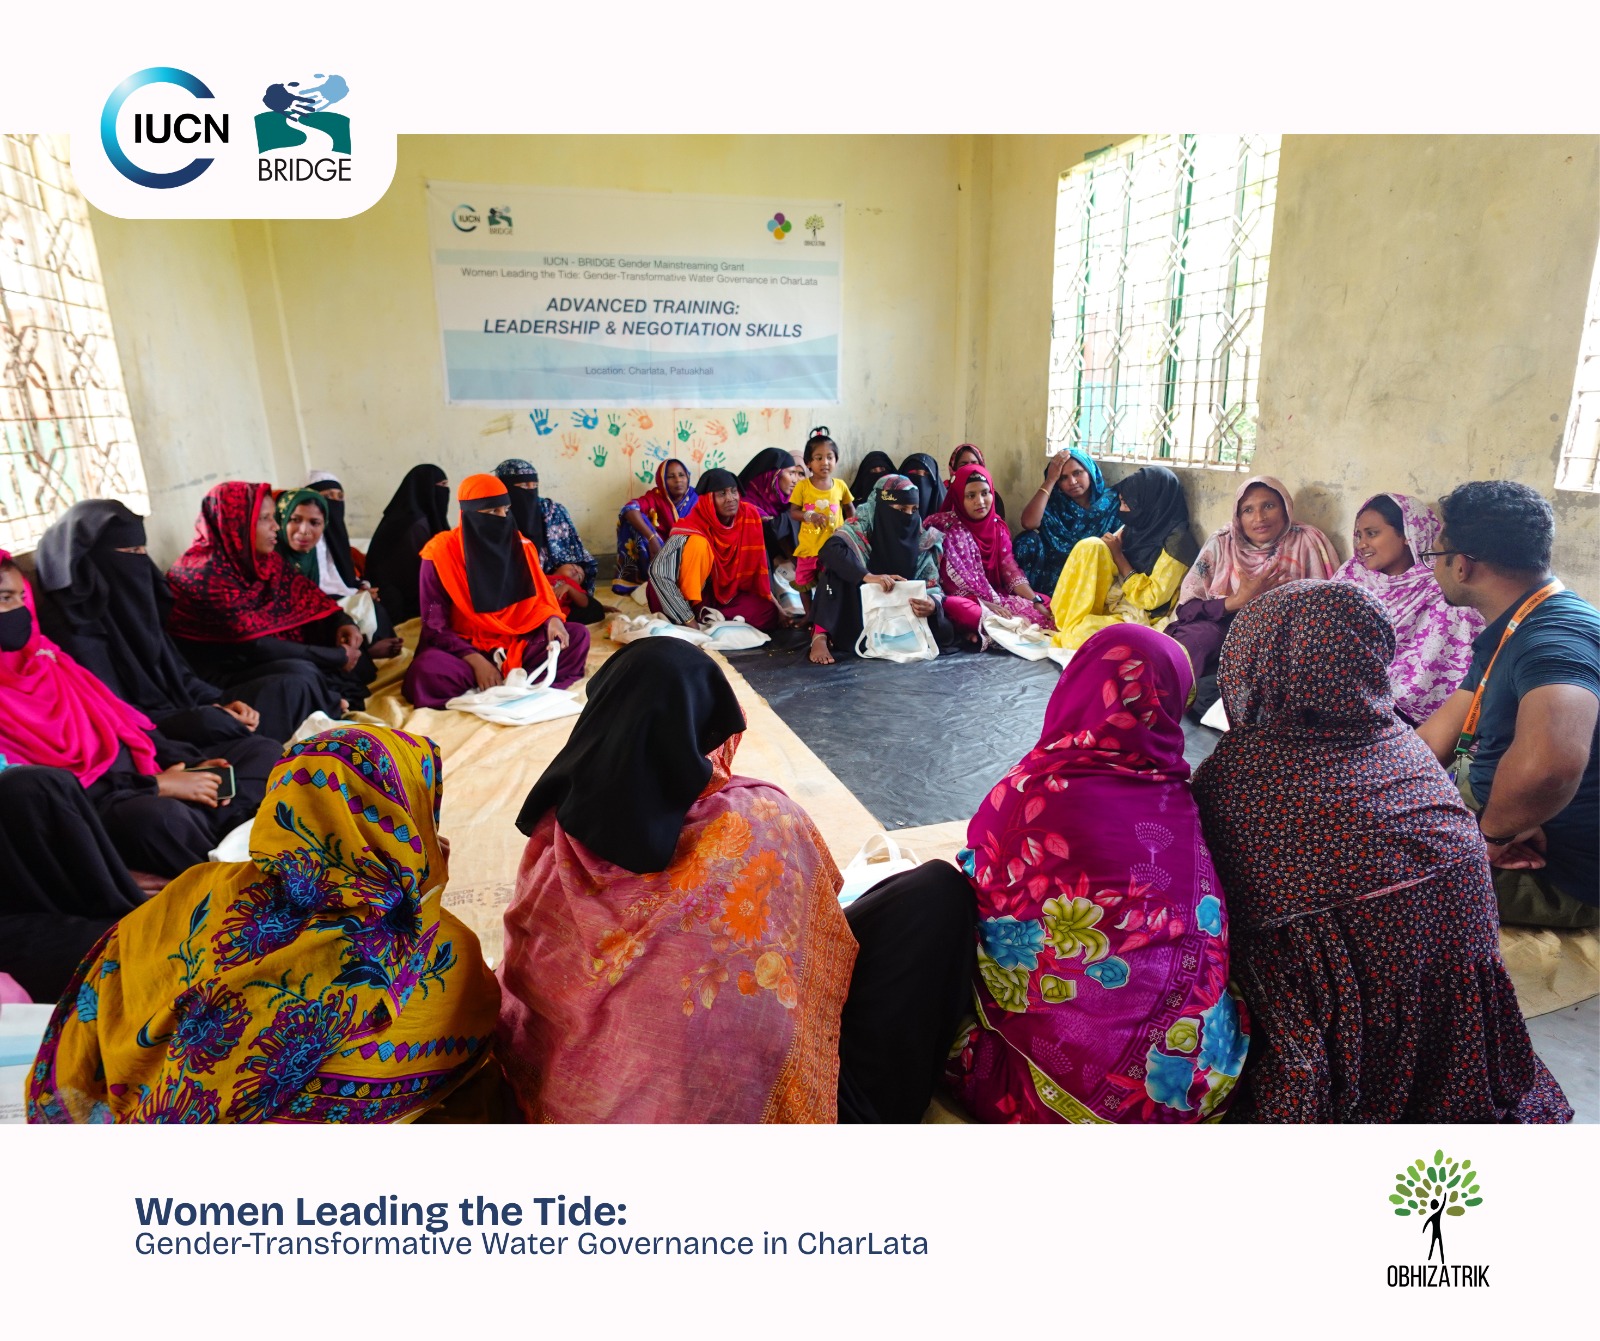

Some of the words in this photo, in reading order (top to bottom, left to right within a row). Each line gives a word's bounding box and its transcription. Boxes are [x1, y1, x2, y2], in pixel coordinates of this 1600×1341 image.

[458, 214, 481, 224] IUCN
[489, 227, 514, 236] BRIDGE
[543, 256, 569, 267] IUCN
[578, 257, 616, 268] BRIDGE
[618, 258, 651, 269] Gender
[654, 260, 718, 272] Mainstreaming
[720, 262, 745, 272] Grant
[461, 267, 499, 277] Women
[501, 268, 539, 281] Leading
[540, 270, 556, 279] the
[558, 269, 580, 280] Tide:
[583, 270, 687, 283] Gender-Transformative
[688, 273, 714, 283] Water
[716, 274, 769, 285] Governance
[770, 276, 778, 285] in
[780, 276, 818, 287] CharLata
[546, 298, 647, 313] ADVANCED
[653, 300, 740, 315] TRAINING:
[483, 319, 600, 335] LEADERSHIP
[605, 321, 616, 335] &
[622, 321, 741, 337] NEGOTIATION
[745, 323, 802, 338] SKILLS
[585, 367, 626, 375] Location:
[628, 366, 668, 376] Charlata,
[670, 367, 714, 376] Patuakhali
